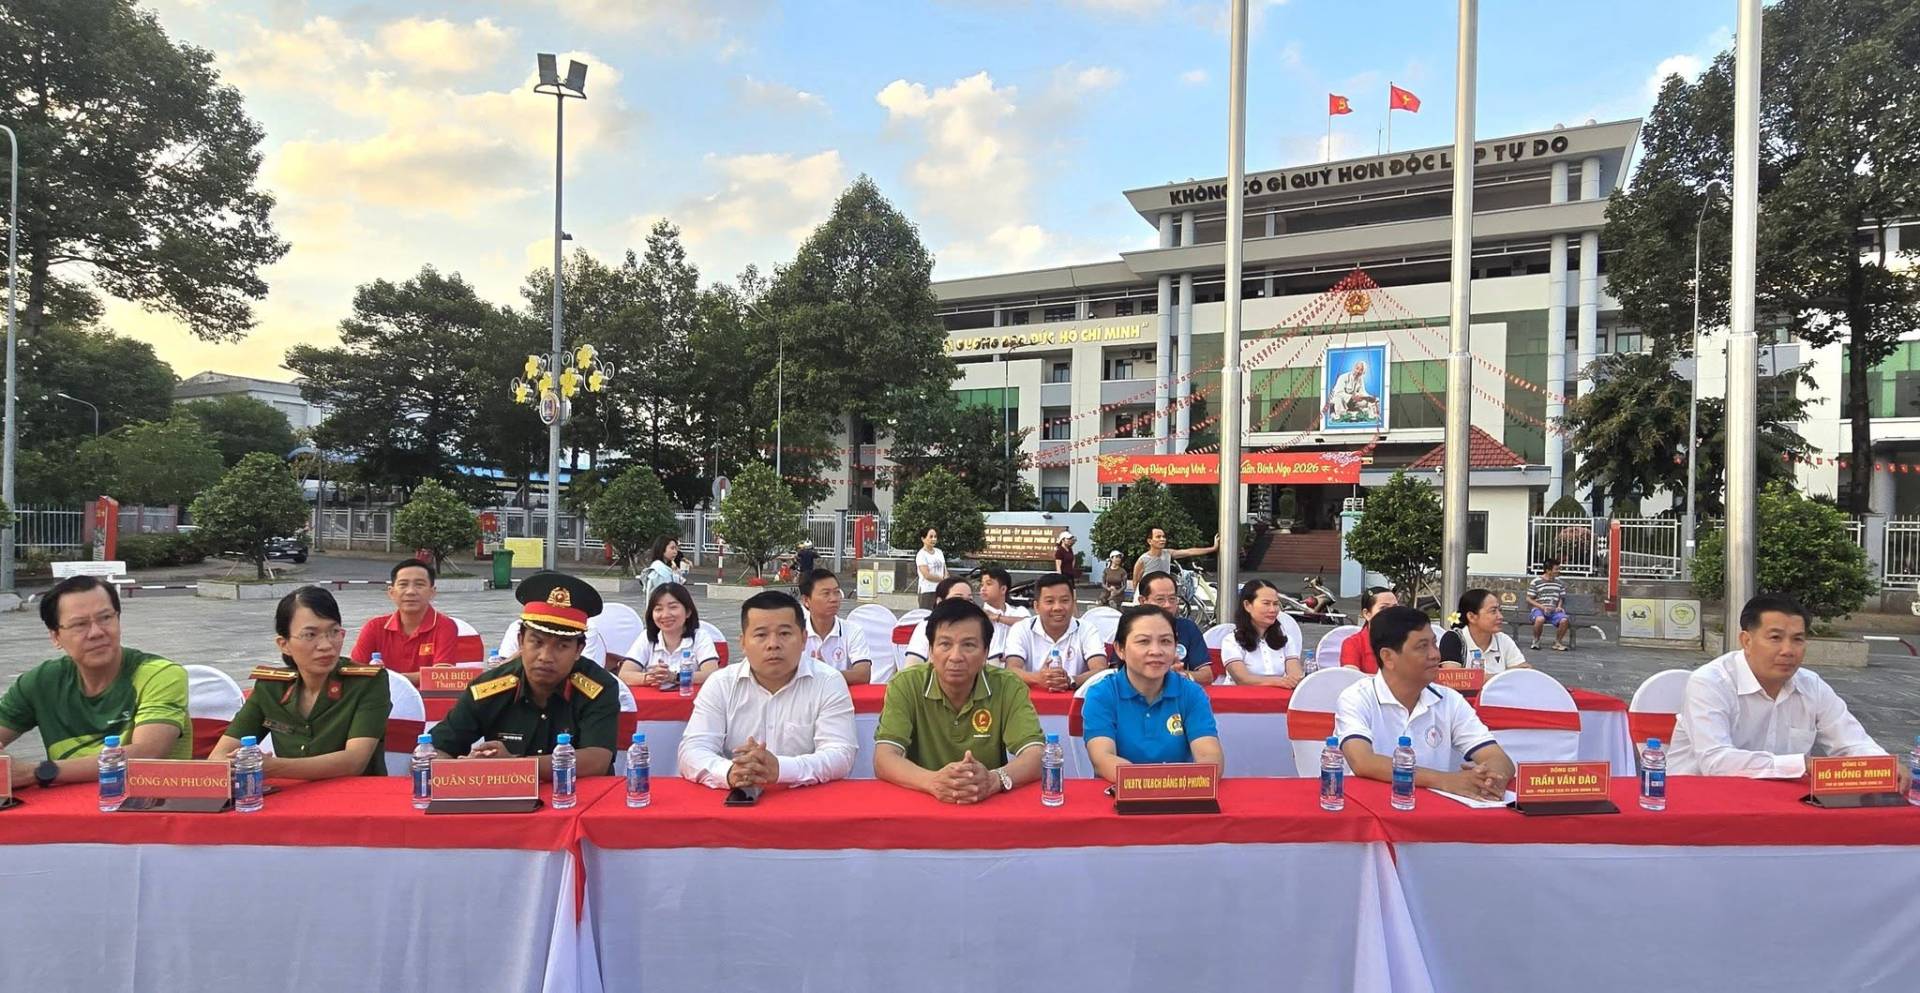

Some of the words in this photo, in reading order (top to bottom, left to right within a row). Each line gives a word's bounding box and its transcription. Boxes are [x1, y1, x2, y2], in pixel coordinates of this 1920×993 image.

[1266, 172, 1287, 193] GÌ
[1290, 166, 1333, 188] QUÝ
[1338, 161, 1384, 183] HƠN
[1389, 153, 1435, 175] ĐỘC
[1440, 147, 1487, 169] LP
[1493, 141, 1526, 162] TỰ
[1532, 135, 1568, 157] DO
[1059, 325, 1078, 344] HỒ
[1081, 325, 1102, 343] CHÍ
[1168, 463, 1189, 478] Quang
[1191, 463, 1206, 474] Vinh
[1293, 462, 1319, 474] 2026
[431, 671, 450, 681] ĐẠI
[451, 670, 474, 681] BIỂU
[436, 681, 456, 689] Tham
[432, 774, 466, 787] QUÂN
[468, 774, 486, 787] SỰ
[486, 773, 536, 785] PHƯỜNG
[1529, 774, 1555, 786] TRẦN
[1864, 768, 1891, 778] MINH
[129, 774, 161, 786] CÔNG
[163, 776, 179, 787] AN
[180, 776, 228, 788] PHƯỜNG
[1162, 774, 1178, 789] ĐẢNG
[1179, 775, 1187, 790] BỘ
[1187, 775, 1211, 789] PHƯỜNG
